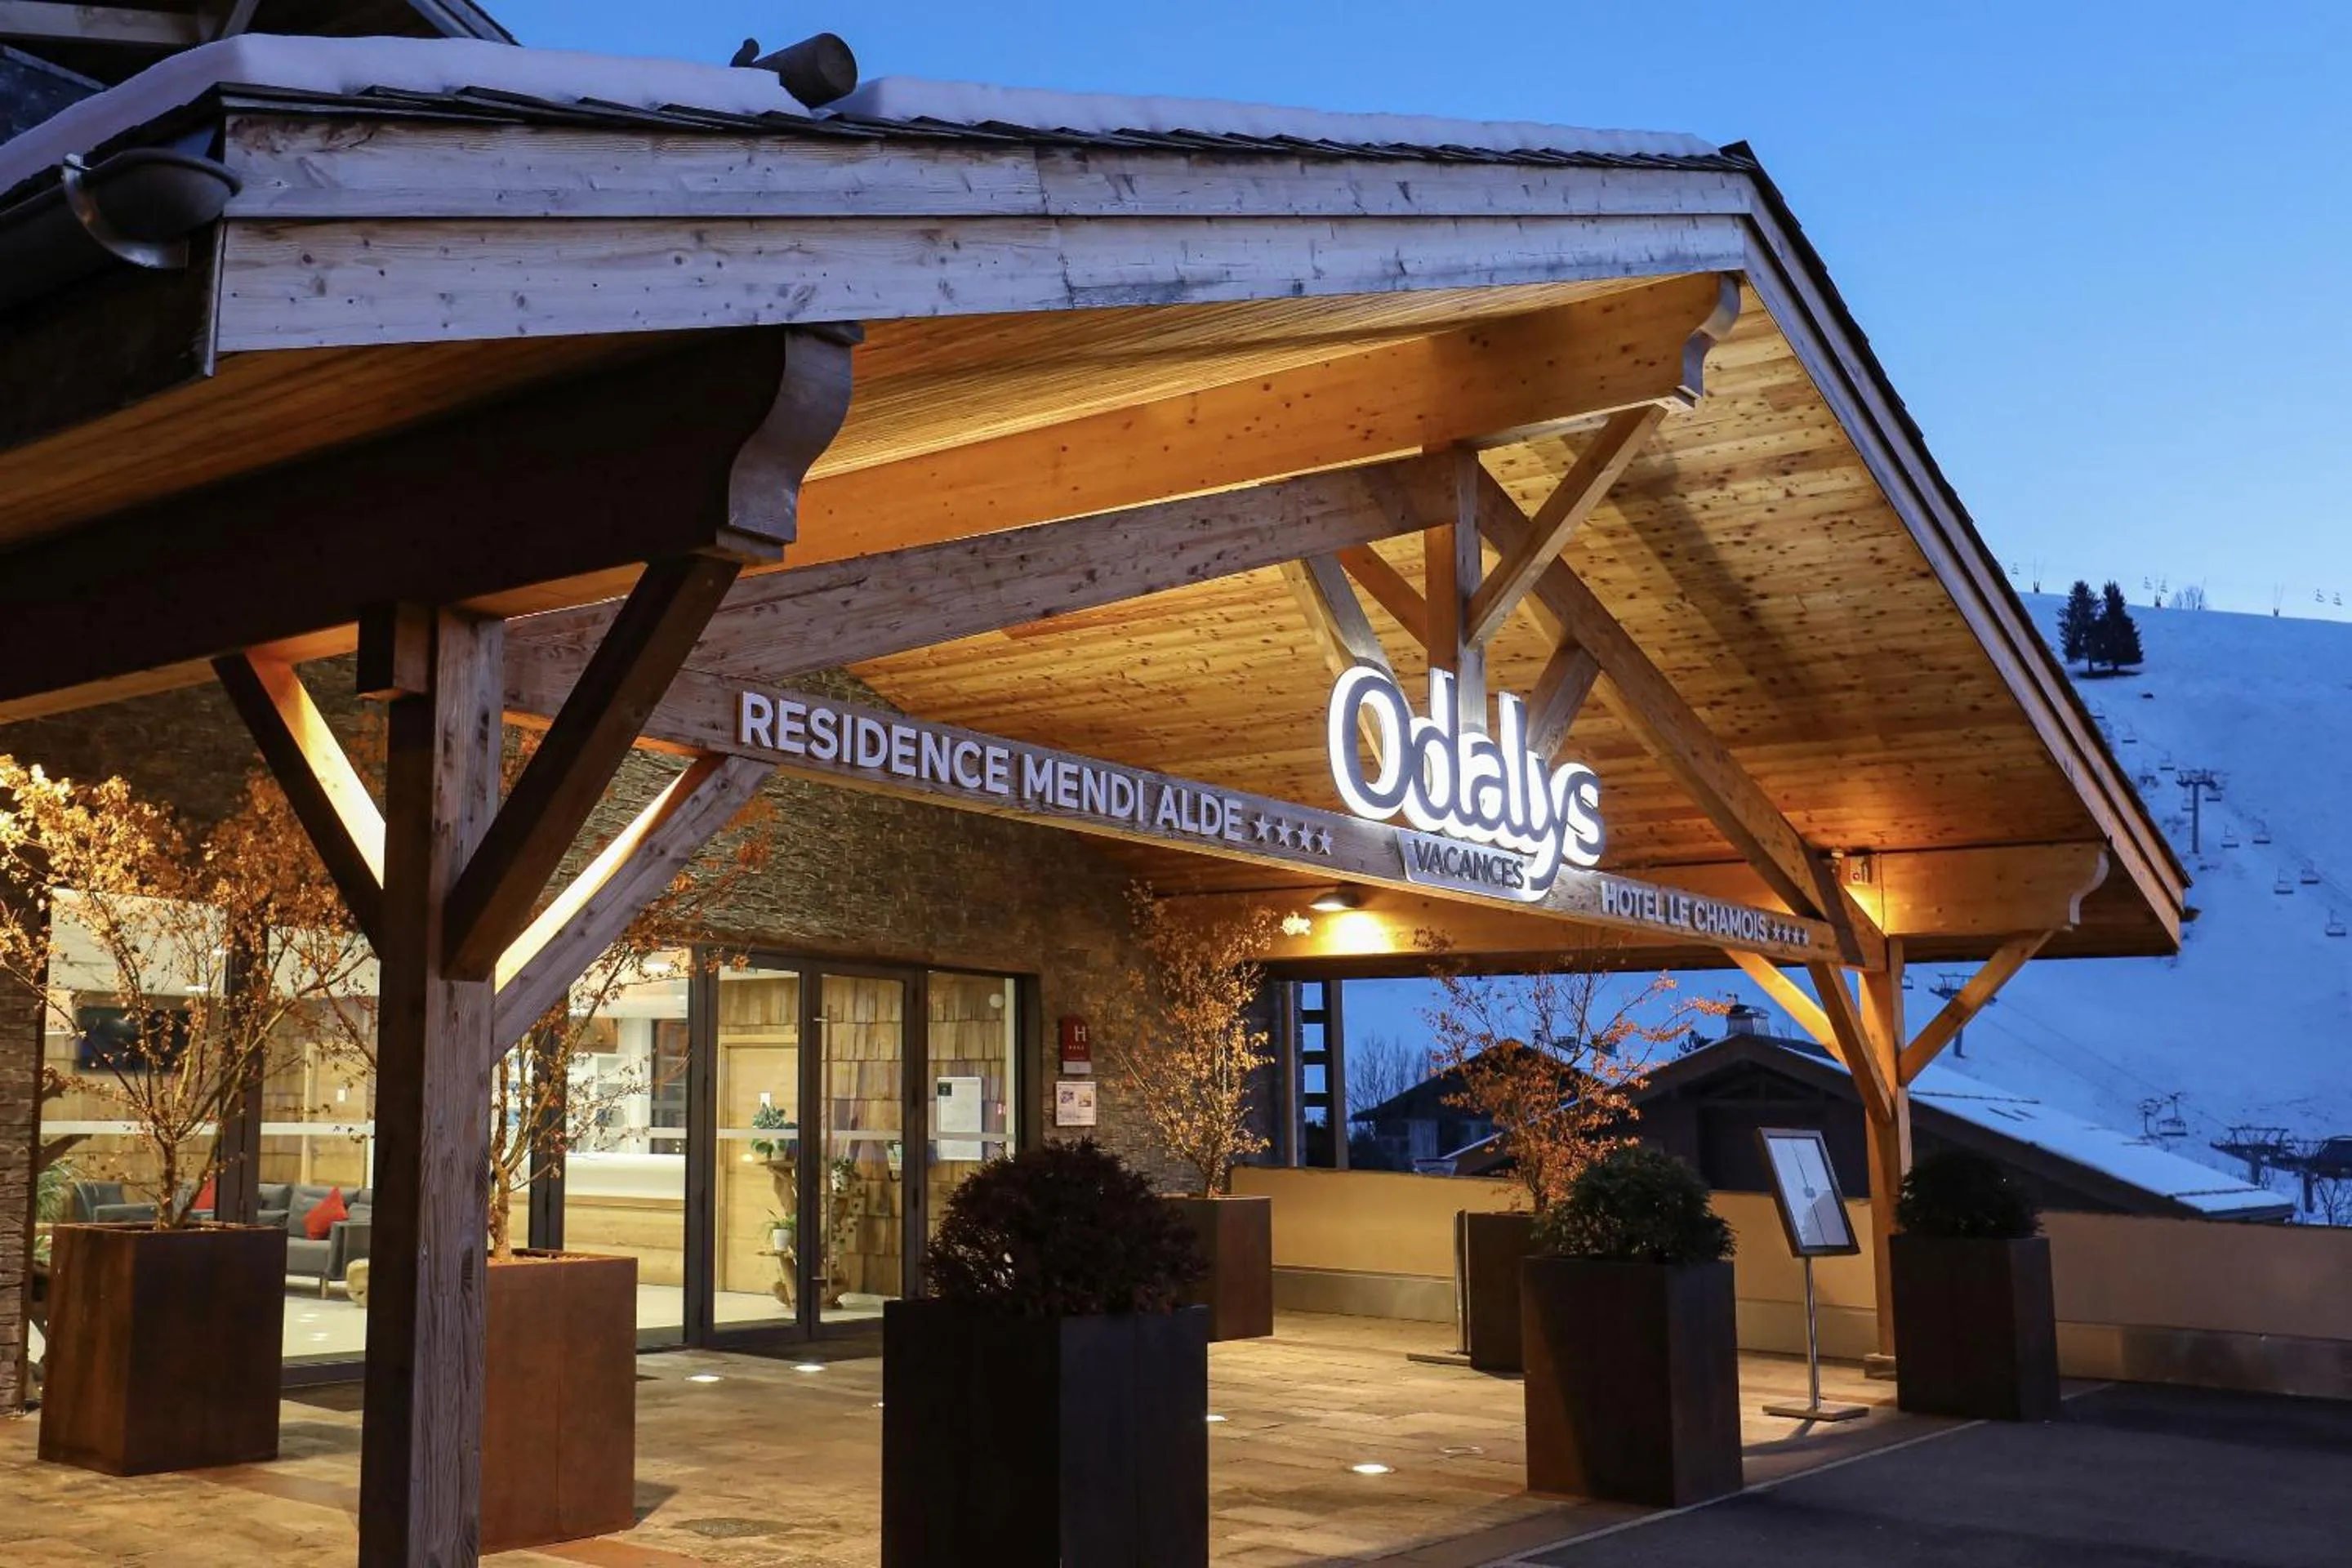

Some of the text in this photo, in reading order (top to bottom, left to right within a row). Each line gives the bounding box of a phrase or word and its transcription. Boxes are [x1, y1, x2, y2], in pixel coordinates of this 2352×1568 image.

[741, 690, 1244, 841] RESIDENCE MENDI ALDE
[1329, 666, 1606, 902] Odalys
[1414, 839, 1525, 889] VACANCES
[1601, 880, 1768, 942] HOTEL LE CHAMOIS
[1074, 1026, 1086, 1042] H
